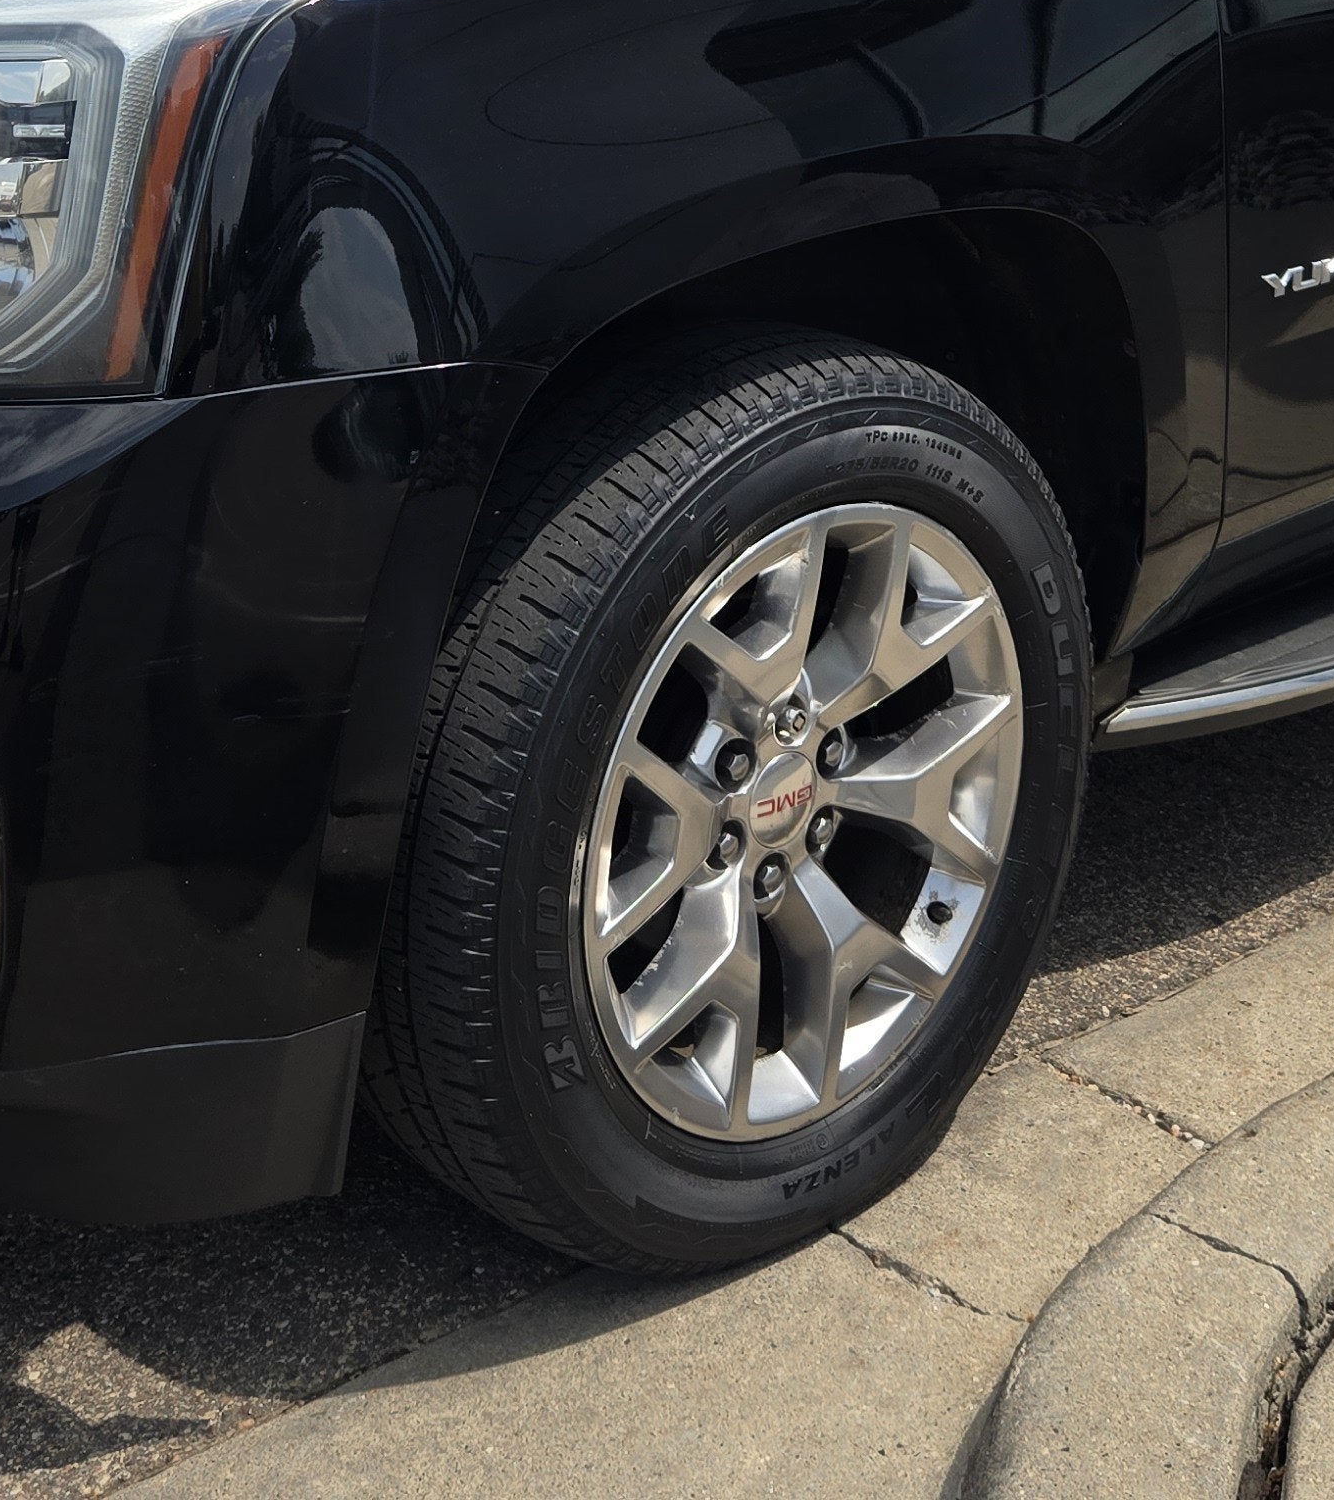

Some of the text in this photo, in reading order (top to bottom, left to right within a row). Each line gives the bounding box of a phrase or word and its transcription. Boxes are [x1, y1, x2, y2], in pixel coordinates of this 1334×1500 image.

[866, 430, 888, 443] TPC
[925, 463, 953, 483] 111S
[955, 477, 985, 503] M+S
[535, 503, 733, 1091] BRIDGESTONE
[756, 784, 812, 818] GMC
[782, 1121, 895, 1200] ALENZA
